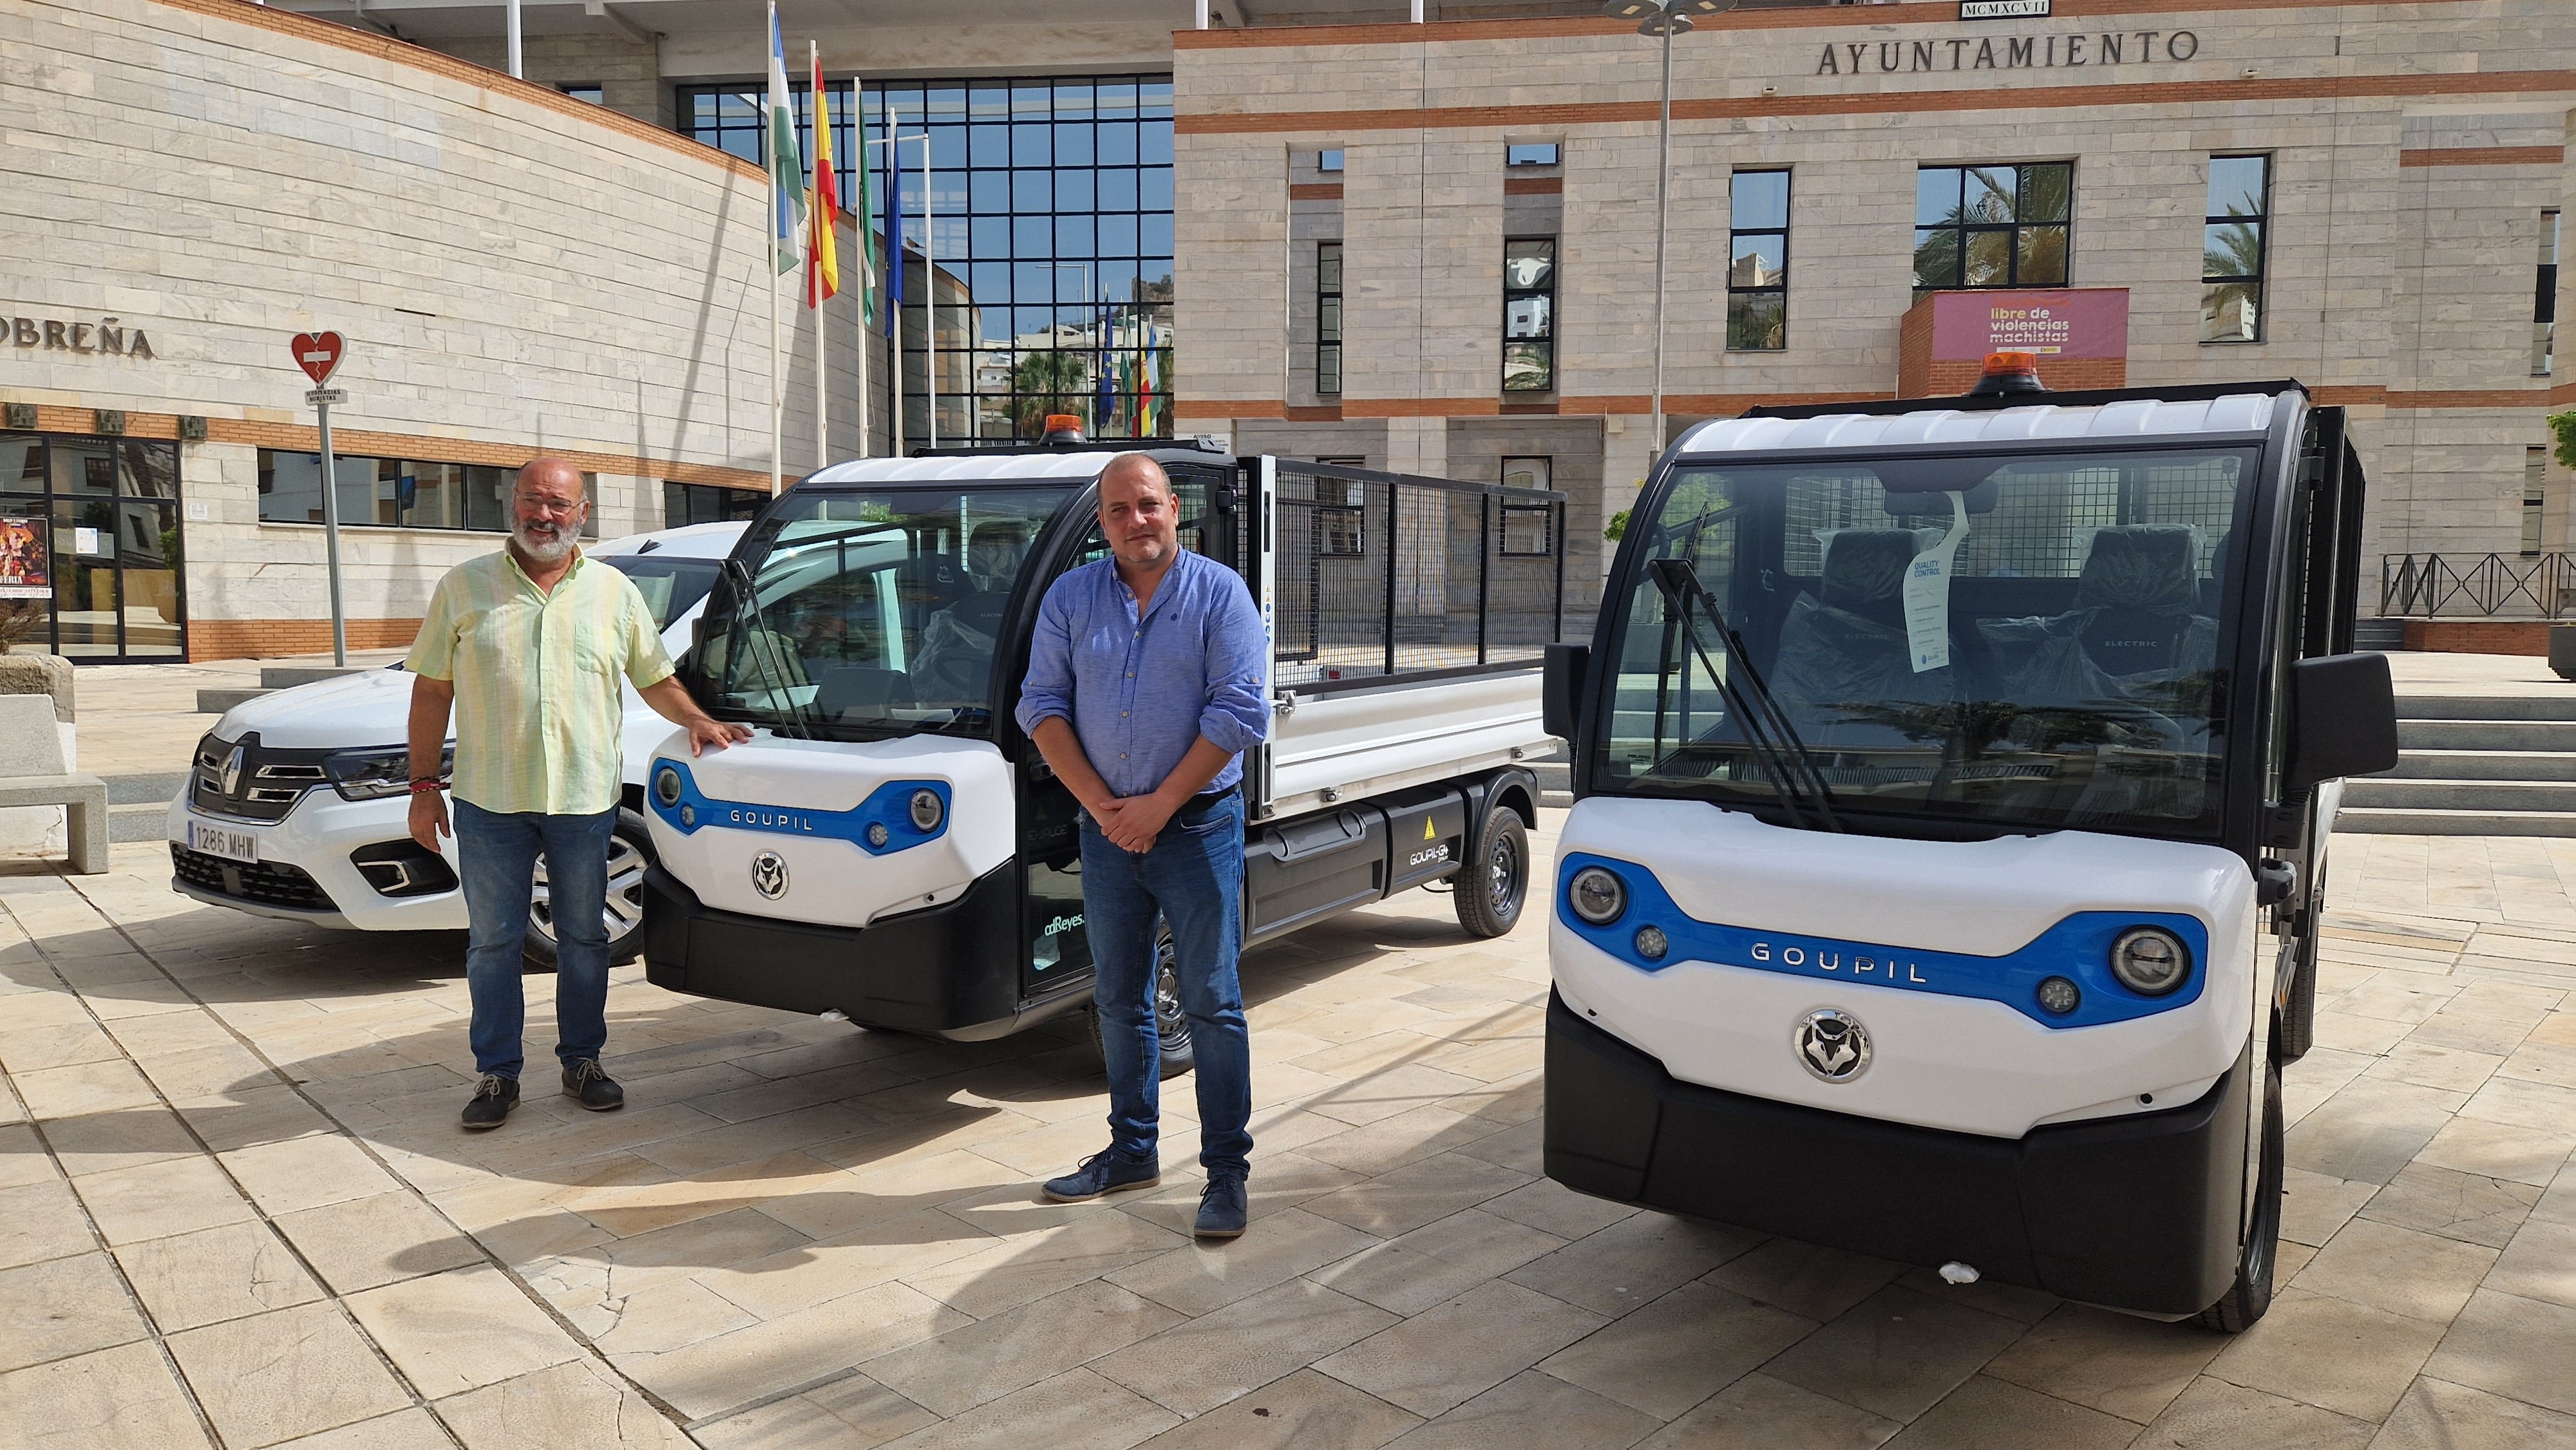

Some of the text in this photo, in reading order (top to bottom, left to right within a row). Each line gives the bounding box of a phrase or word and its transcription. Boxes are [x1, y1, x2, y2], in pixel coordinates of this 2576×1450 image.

[1965, 2, 2046, 15] MCMXCVII
[1816, 31, 2198, 75] AYUNTAMIENTO
[1991, 307, 2050, 319] libre de
[1991, 319, 2069, 331] violencias
[1990, 331, 2069, 343] machistas
[1915, 560, 1939, 570] QUALITY
[1915, 568, 1941, 578] CONTROL
[730, 810, 812, 830] GOUPIL
[197, 827, 254, 859] 1286 MHW
[1751, 943, 1926, 983] GOUPIL
